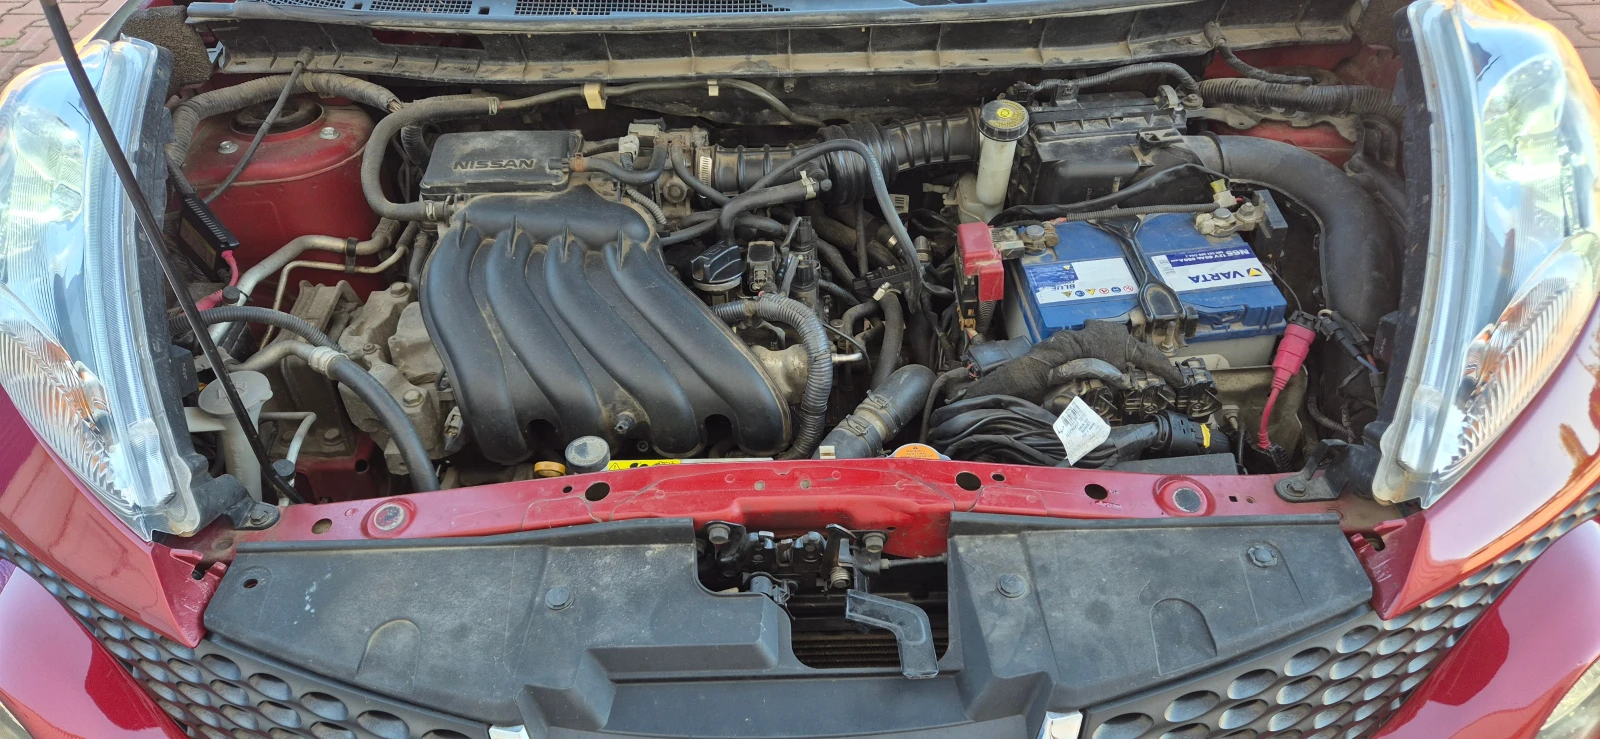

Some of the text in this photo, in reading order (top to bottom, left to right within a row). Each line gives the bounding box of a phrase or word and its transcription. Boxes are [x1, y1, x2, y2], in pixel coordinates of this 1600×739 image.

[453, 158, 536, 171] NISSAN
[1226, 248, 1250, 257] N65
[1188, 270, 1245, 284] VARTA
